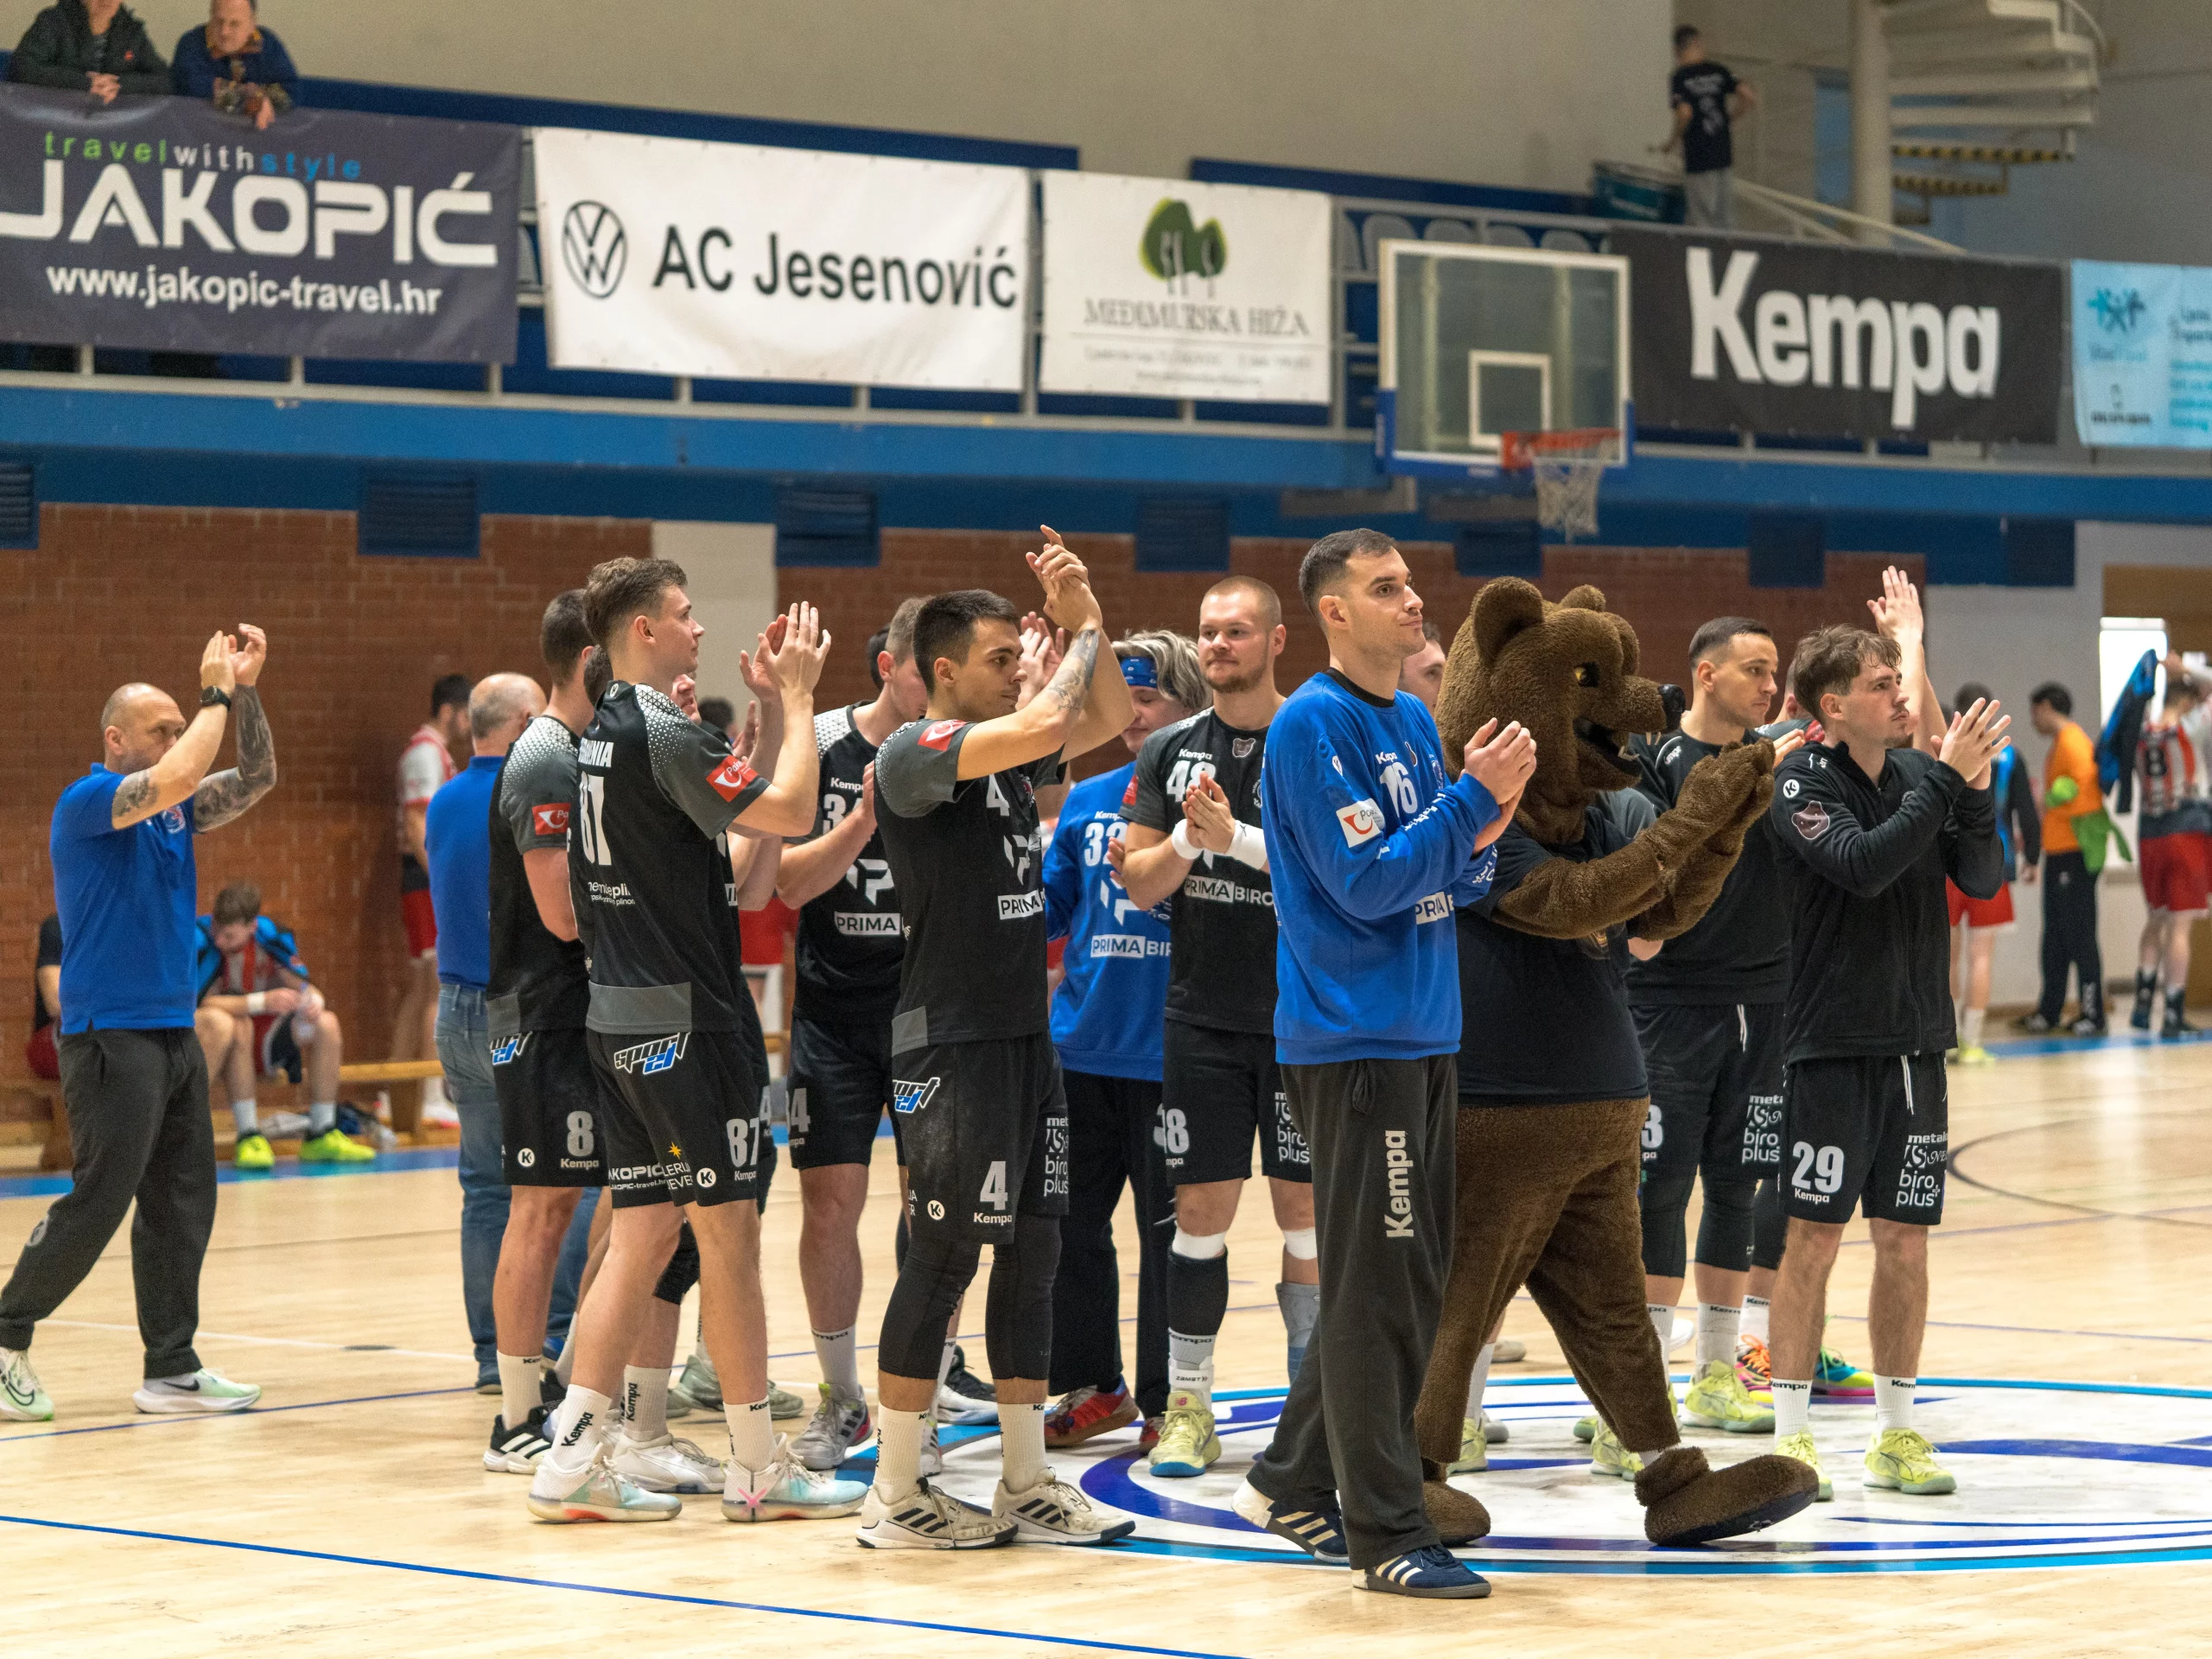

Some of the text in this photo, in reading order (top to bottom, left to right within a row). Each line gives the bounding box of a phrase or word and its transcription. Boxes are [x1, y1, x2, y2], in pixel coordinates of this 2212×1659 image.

[0, 159, 498, 268] JAKOPIĆ
[652, 225, 1017, 308] AC Jesenović
[46, 264, 442, 314] www.jakopic-travel.hr
[1686, 246, 2000, 430] Kempa
[1179, 748, 1213, 761] Kempa
[986, 773, 1010, 816] 4
[1379, 761, 1418, 818] 16
[1185, 879, 1230, 899] PRIMA
[837, 916, 897, 931] PRIMA
[1092, 937, 1141, 955] PRIMA
[567, 1110, 594, 1156] 8
[727, 1116, 760, 1167] 87
[1743, 1127, 1778, 1147] biro
[560, 1158, 600, 1170] Kempa
[1279, 1147, 1310, 1163] plus
[1791, 1141, 1845, 1193] 29
[734, 1170, 757, 1182] Kempa
[980, 1161, 1008, 1210] 4
[1383, 1130, 1414, 1237] Kempa
[1899, 1168, 1935, 1189] biro
[1795, 1187, 1830, 1205] Kempa
[973, 1212, 1013, 1225] Kempa
[624, 1382, 640, 1421] Kempa
[561, 1411, 594, 1446] Kempa
